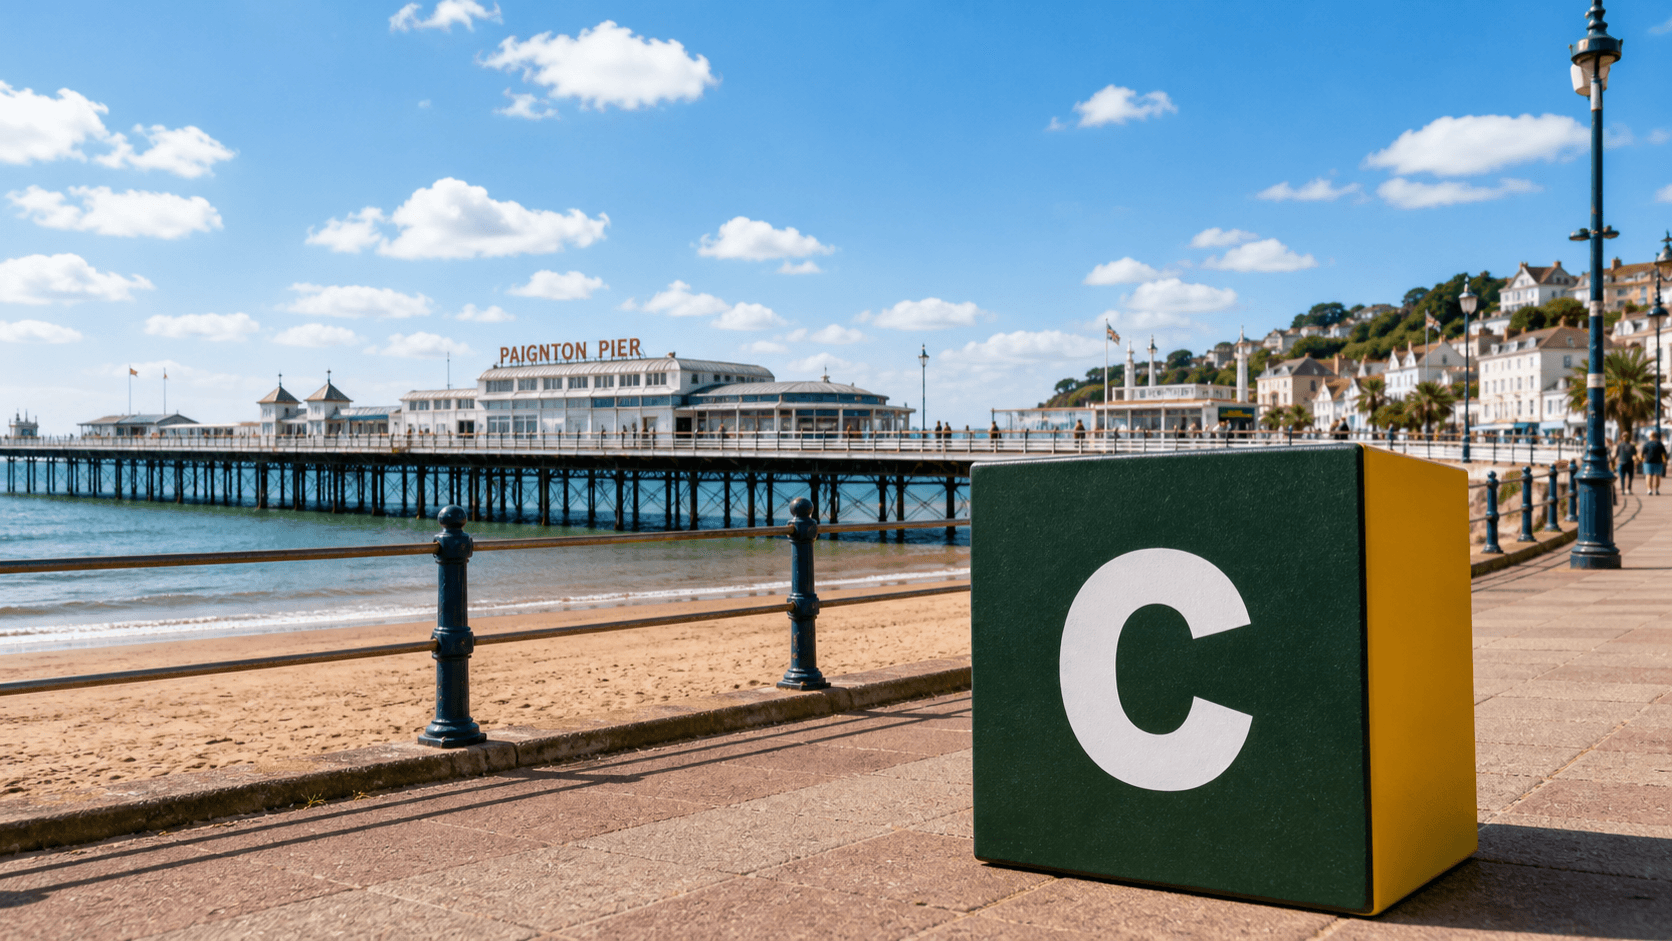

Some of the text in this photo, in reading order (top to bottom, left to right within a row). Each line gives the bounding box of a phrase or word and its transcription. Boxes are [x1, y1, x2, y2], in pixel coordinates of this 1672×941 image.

[500, 338, 641, 364] PAIGNTON PIER
[1059, 548, 1253, 792] C
